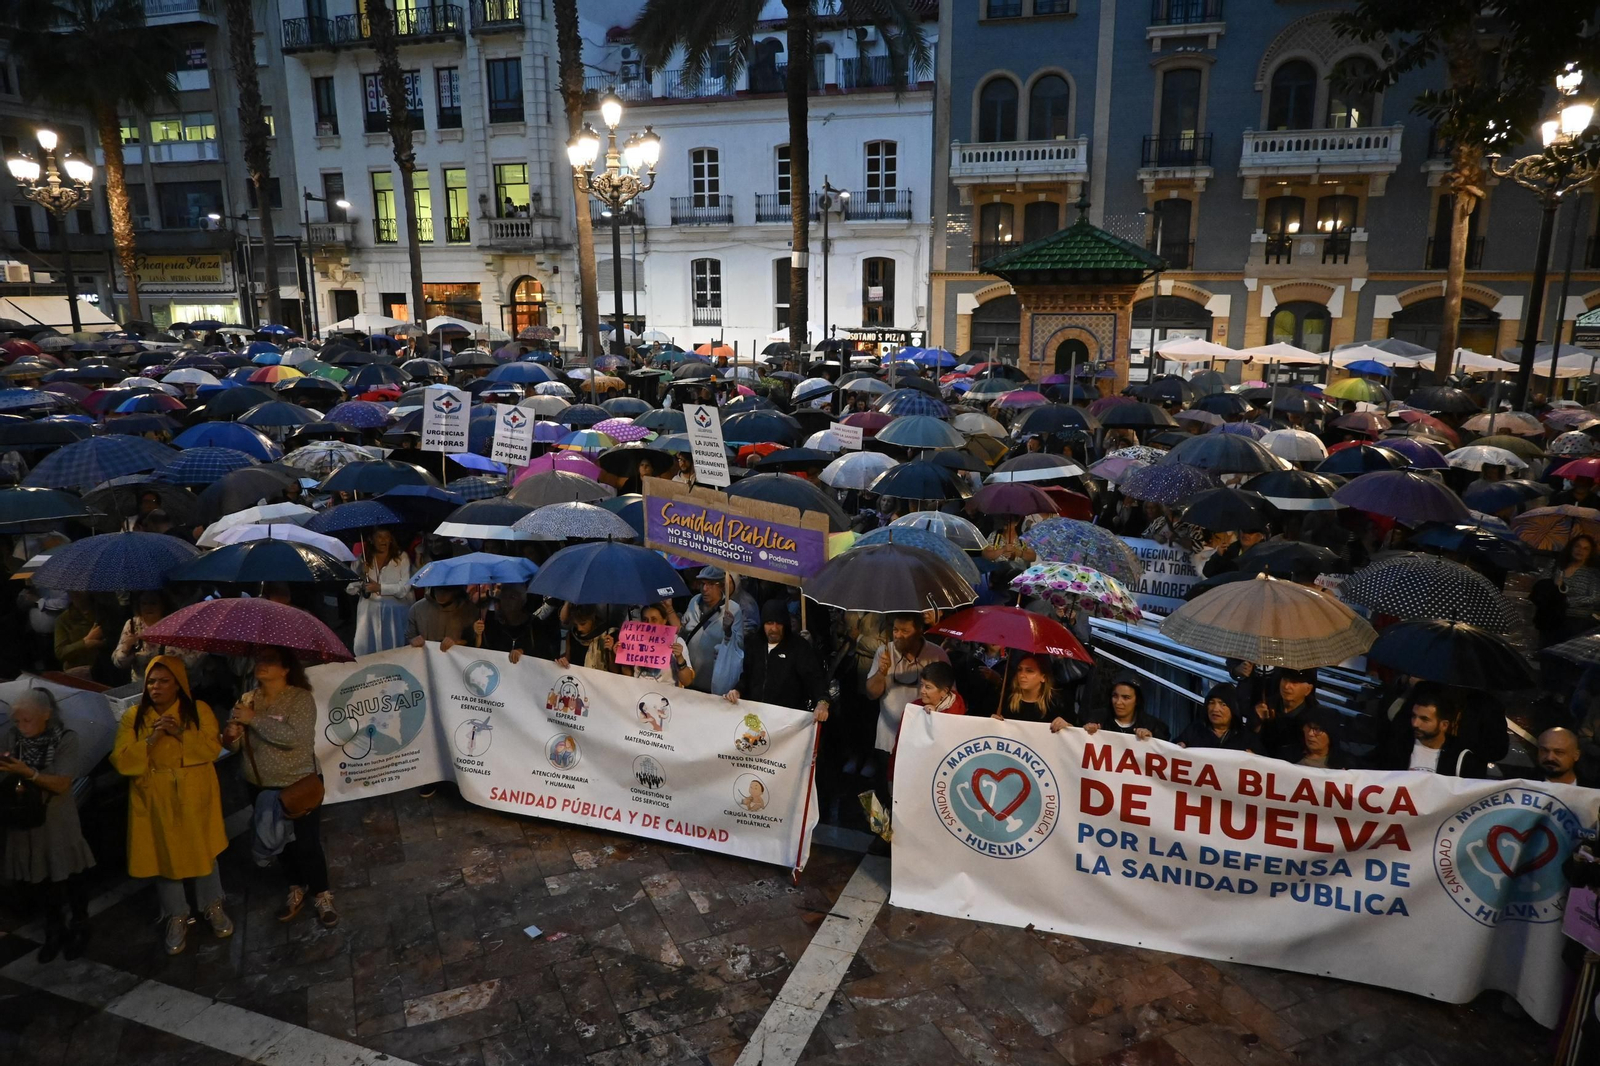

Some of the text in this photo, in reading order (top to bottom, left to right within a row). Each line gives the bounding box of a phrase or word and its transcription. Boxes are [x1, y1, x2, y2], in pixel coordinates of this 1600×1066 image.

[427, 429, 465, 437] URGENCIAS
[497, 442, 528, 451] URGENCIAS
[703, 441, 720, 449] JUNTA
[505, 453, 527, 461] HORAS
[695, 450, 724, 459] PERJUDICA
[695, 460, 726, 469] SERIAMENTE
[708, 470, 724, 478] SALUD
[661, 502, 797, 552] Sanidad Pública
[667, 528, 754, 555] NO ES UN NEGOCIO...
[678, 538, 689, 548] ES
[690, 541, 701, 551] UN
[702, 543, 741, 560] DERECHO
[742, 552, 753, 563] !!!
[1141, 547, 1181, 563] VECINAL
[768, 552, 799, 567] Podemos
[1154, 562, 1166, 573] LA
[1168, 563, 1198, 577] TORRE
[635, 624, 657, 633] VIDA
[625, 633, 645, 642] VALE
[621, 642, 635, 651] QUE
[1045, 645, 1064, 656] UGT
[626, 653, 667, 665] RECORTES
[328, 690, 425, 725] ONUSAP
[450, 694, 469, 702] FALTA
[478, 698, 505, 708] SERVICIOS
[460, 703, 493, 714] ESENCIALES
[555, 711, 577, 721] ESPERAS
[546, 717, 586, 732] INTERMINABLES
[638, 730, 664, 741] HOSPITAL
[624, 735, 675, 752] MATERNO-INFANTIL
[371, 758, 385, 766] lucha
[386, 756, 395, 764] por
[401, 749, 421, 758] sanidad
[717, 753, 744, 761] RETRASO
[754, 757, 787, 770] URGENCIAS
[946, 740, 1046, 779] MAREA BLANCA
[736, 762, 776, 775] EMERGENCIAS
[531, 770, 589, 784] ATENCIÓN PRIMARIA
[1081, 742, 1419, 816] MAREA BLANCA
[549, 781, 576, 790] HUMANA
[630, 787, 664, 799] CONGESTIÓN
[643, 798, 670, 808] SERVICIOS
[936, 780, 957, 827] SANIDAD
[1454, 792, 1515, 824] MAREA
[489, 787, 730, 843] SANIDAD PÚBLICA Y DE CALIDAD
[723, 809, 748, 818] CIRUGÍA
[748, 812, 779, 823] TORÁCICA
[1034, 794, 1058, 837] PÚBLICA
[1079, 777, 1412, 854] DE HUELVA
[736, 818, 771, 829] PEDIÁTRICA
[1576, 828, 1596, 841] tve
[965, 833, 1027, 856] HUELVA
[1077, 822, 1411, 888] POR LA DEFENSA DE
[1439, 838, 1464, 894] SANIDAD
[1075, 852, 1410, 917] LA SANIDAD PÚBLICA
